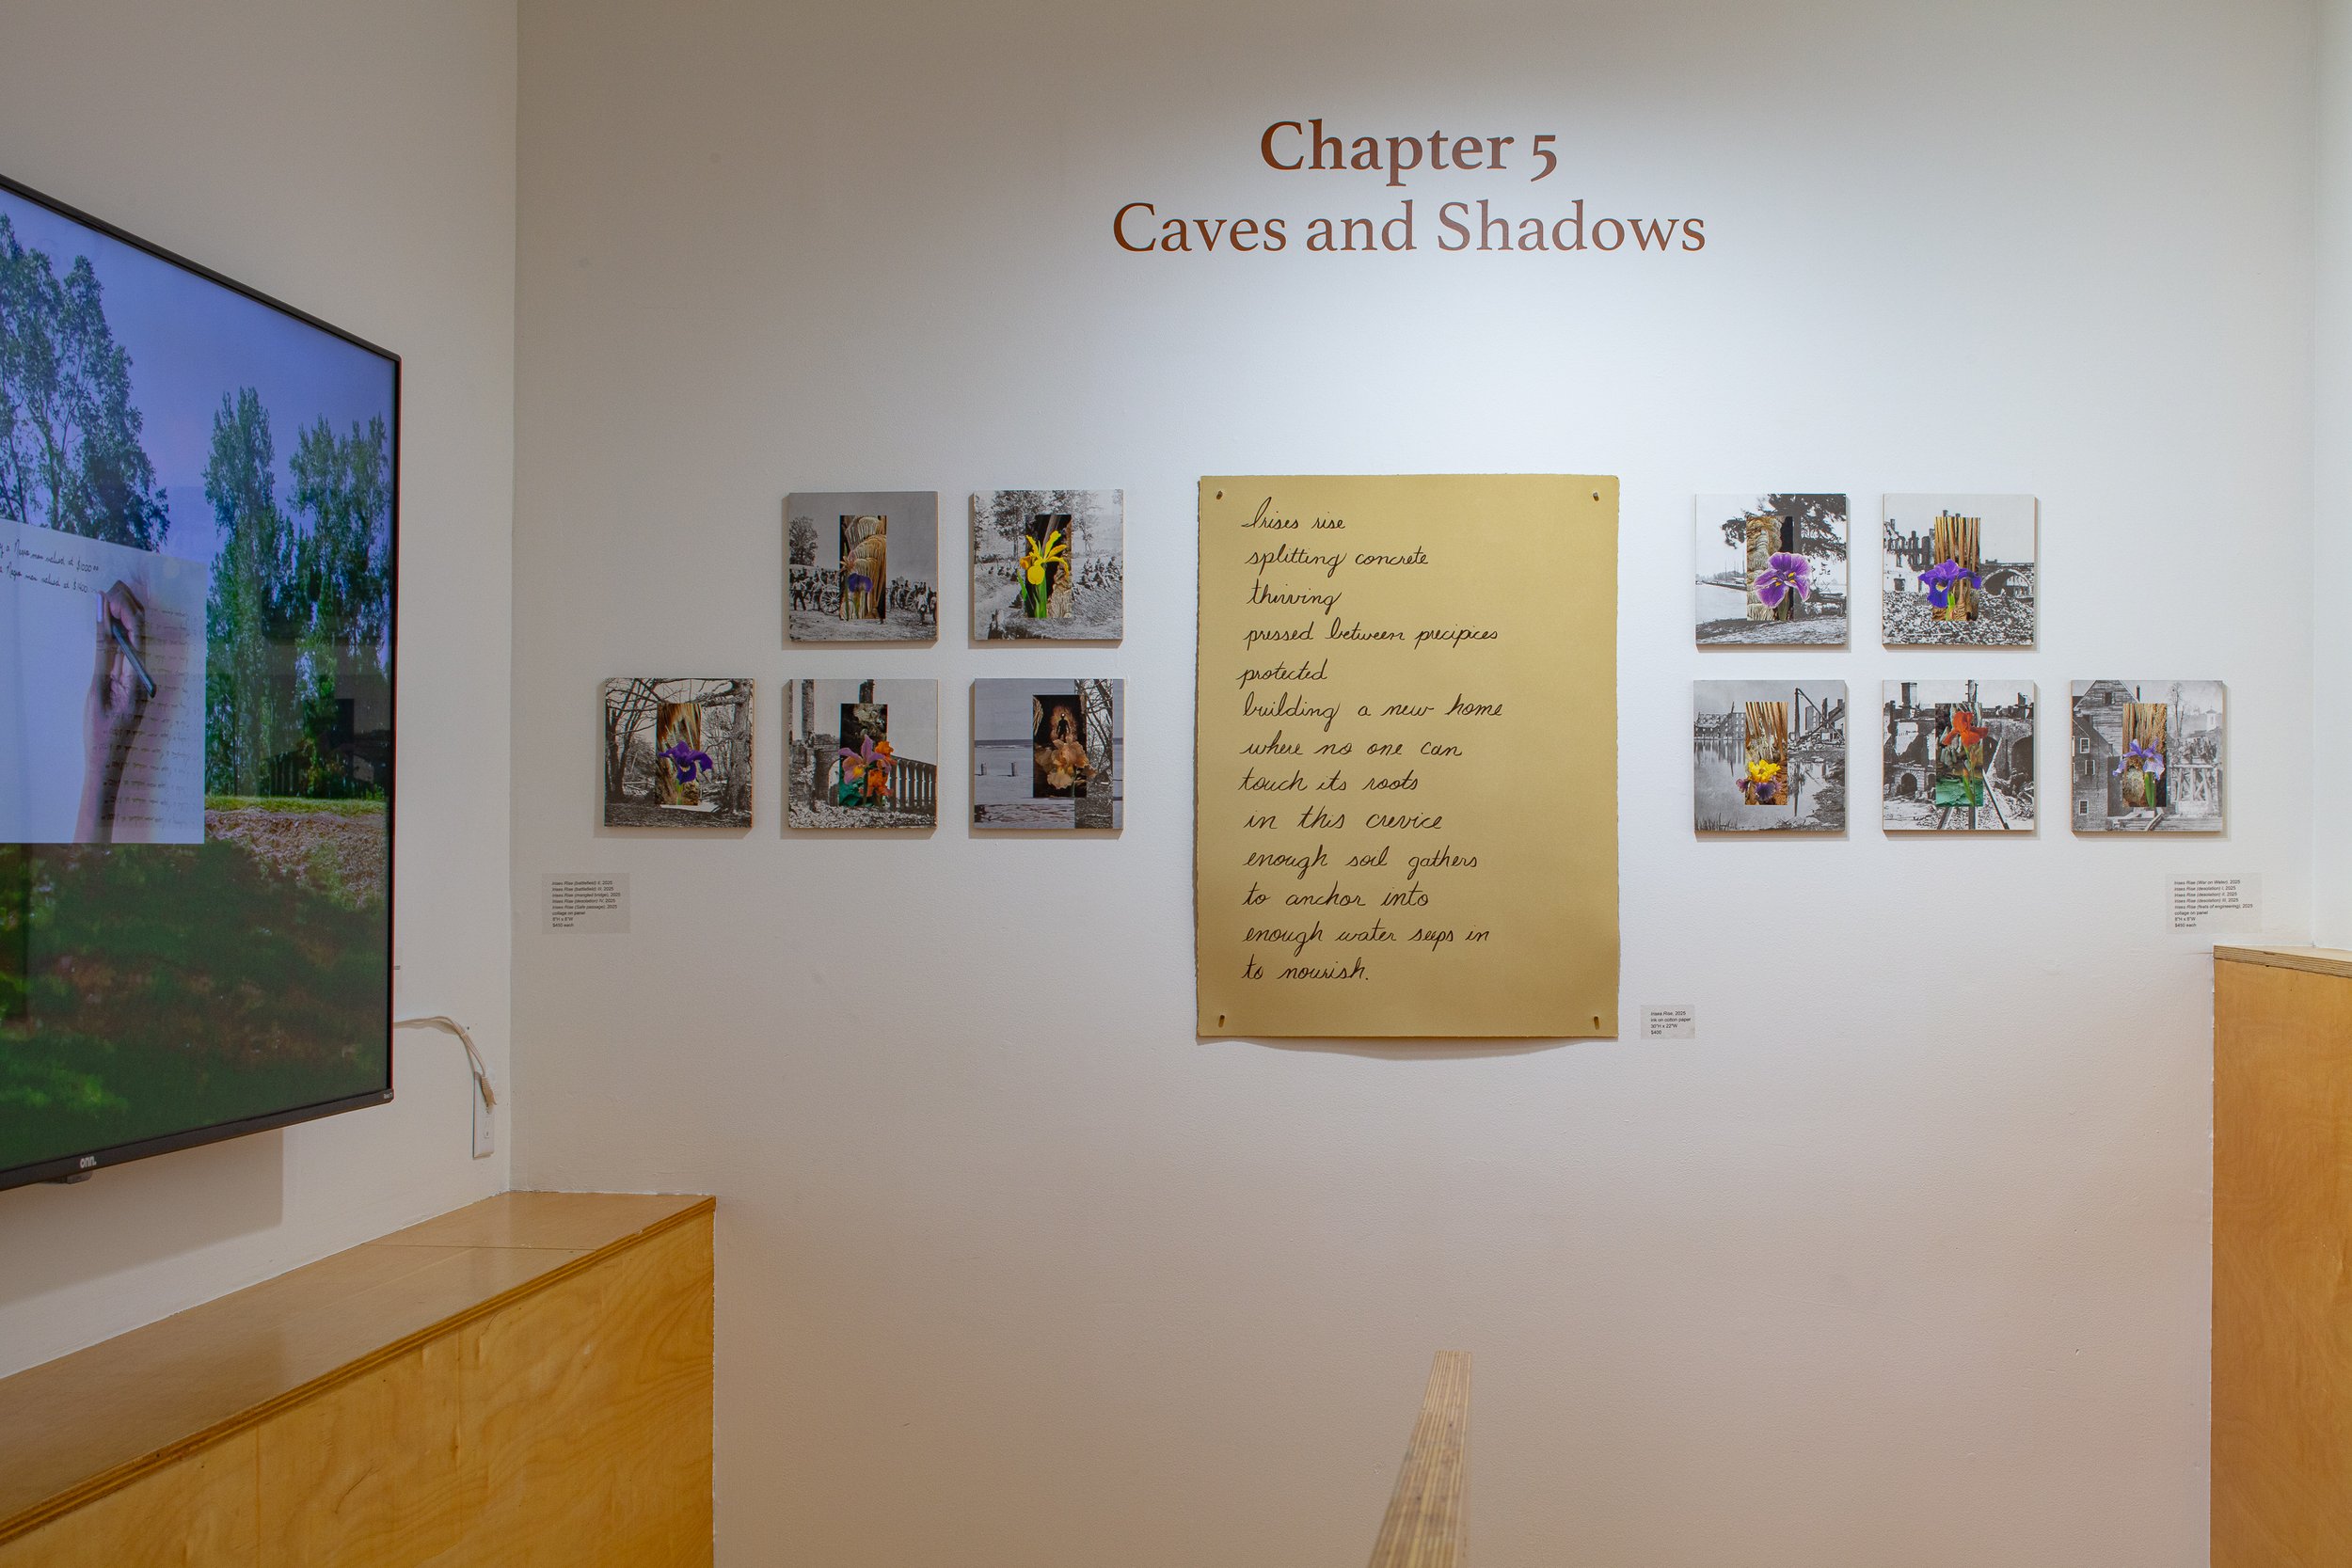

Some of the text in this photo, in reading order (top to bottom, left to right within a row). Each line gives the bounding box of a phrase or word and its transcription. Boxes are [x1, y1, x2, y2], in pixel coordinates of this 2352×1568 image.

[1261, 119, 1557, 186] Chapter 5
[1114, 199, 1705, 251] Caves and Shadows
[1241, 497, 1345, 530] Irises rise
[1245, 544, 1428, 578] splitting concrete
[1247, 578, 1342, 615] thriving
[1243, 617, 1498, 651] pressed between precipices
[1236, 658, 1327, 689] protected
[1243, 691, 1502, 732] building a new home
[1239, 730, 1462, 756] where no one can
[1238, 767, 1418, 791] touch its roots
[1243, 805, 1442, 830] in this crevice
[1243, 845, 1477, 880] enough soil gathers
[1242, 880, 1428, 906] to anchor into
[1242, 918, 1489, 958] enough water seeps in
[1241, 954, 1368, 980] to nourish.
